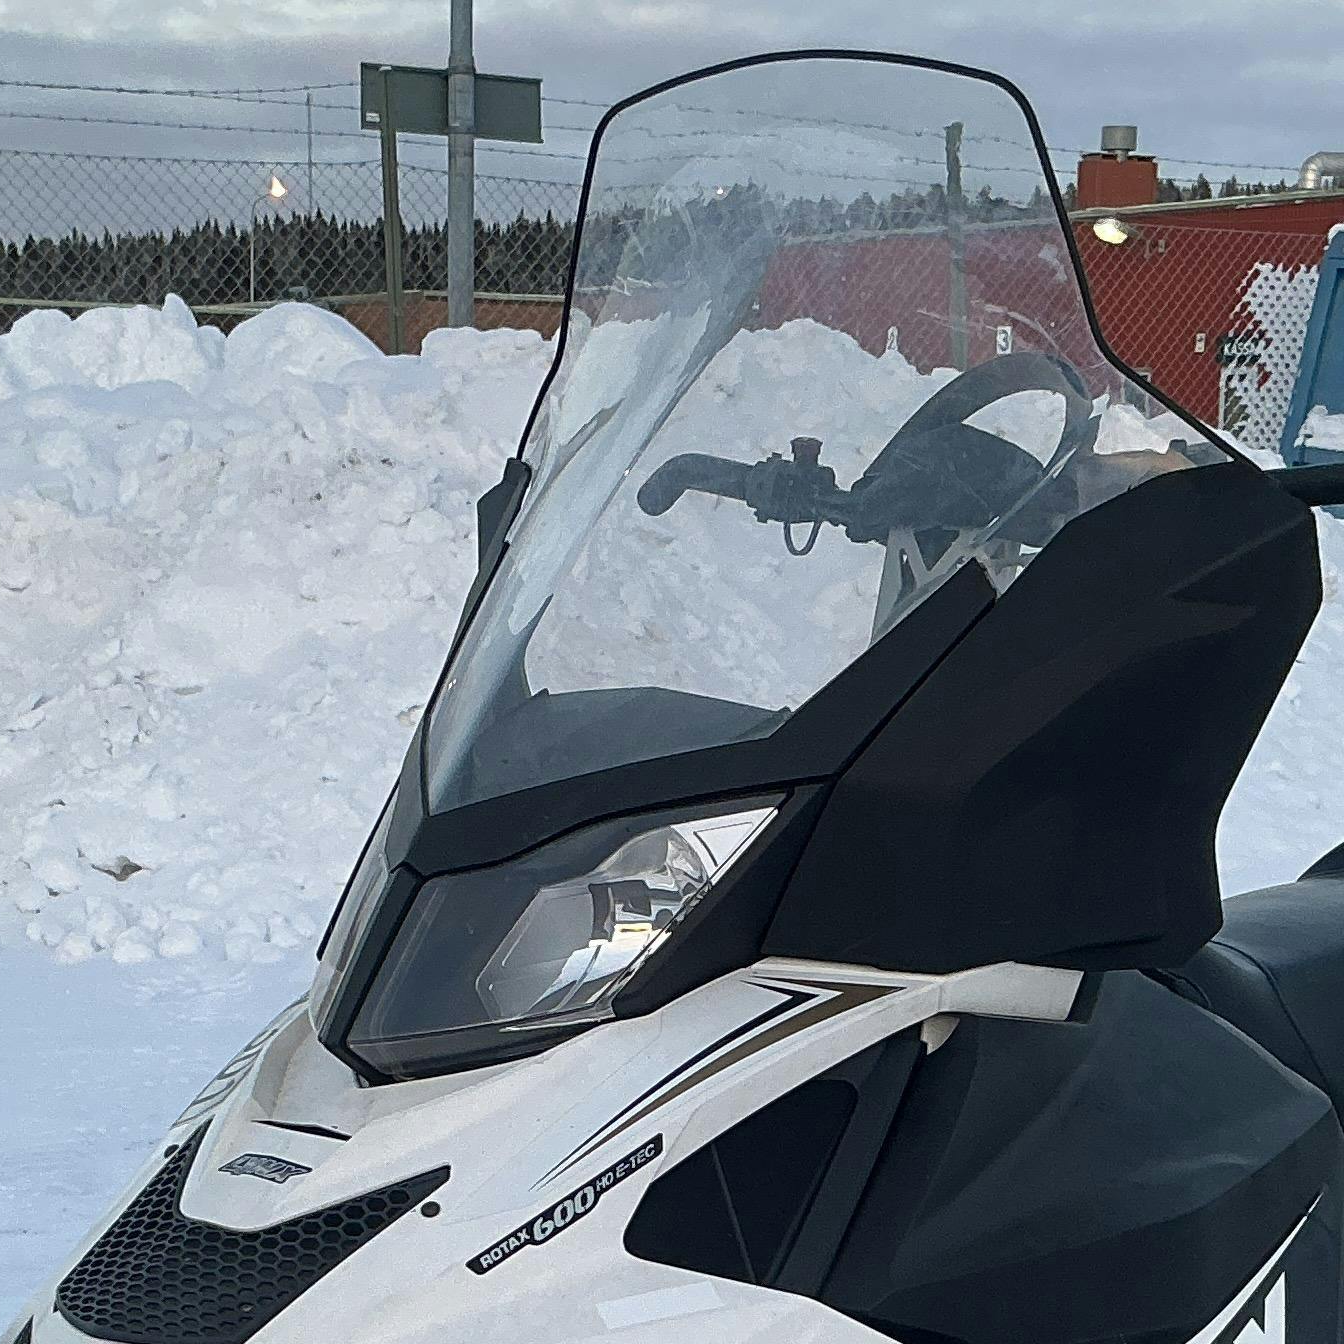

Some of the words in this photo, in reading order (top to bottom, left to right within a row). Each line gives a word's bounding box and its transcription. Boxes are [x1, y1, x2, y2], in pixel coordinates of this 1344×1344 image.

[480, 1228, 531, 1269] ROTAX
[532, 1186, 595, 1241] 600
[596, 1172, 614, 1192] HO
[615, 1143, 656, 1179] E-TEC
